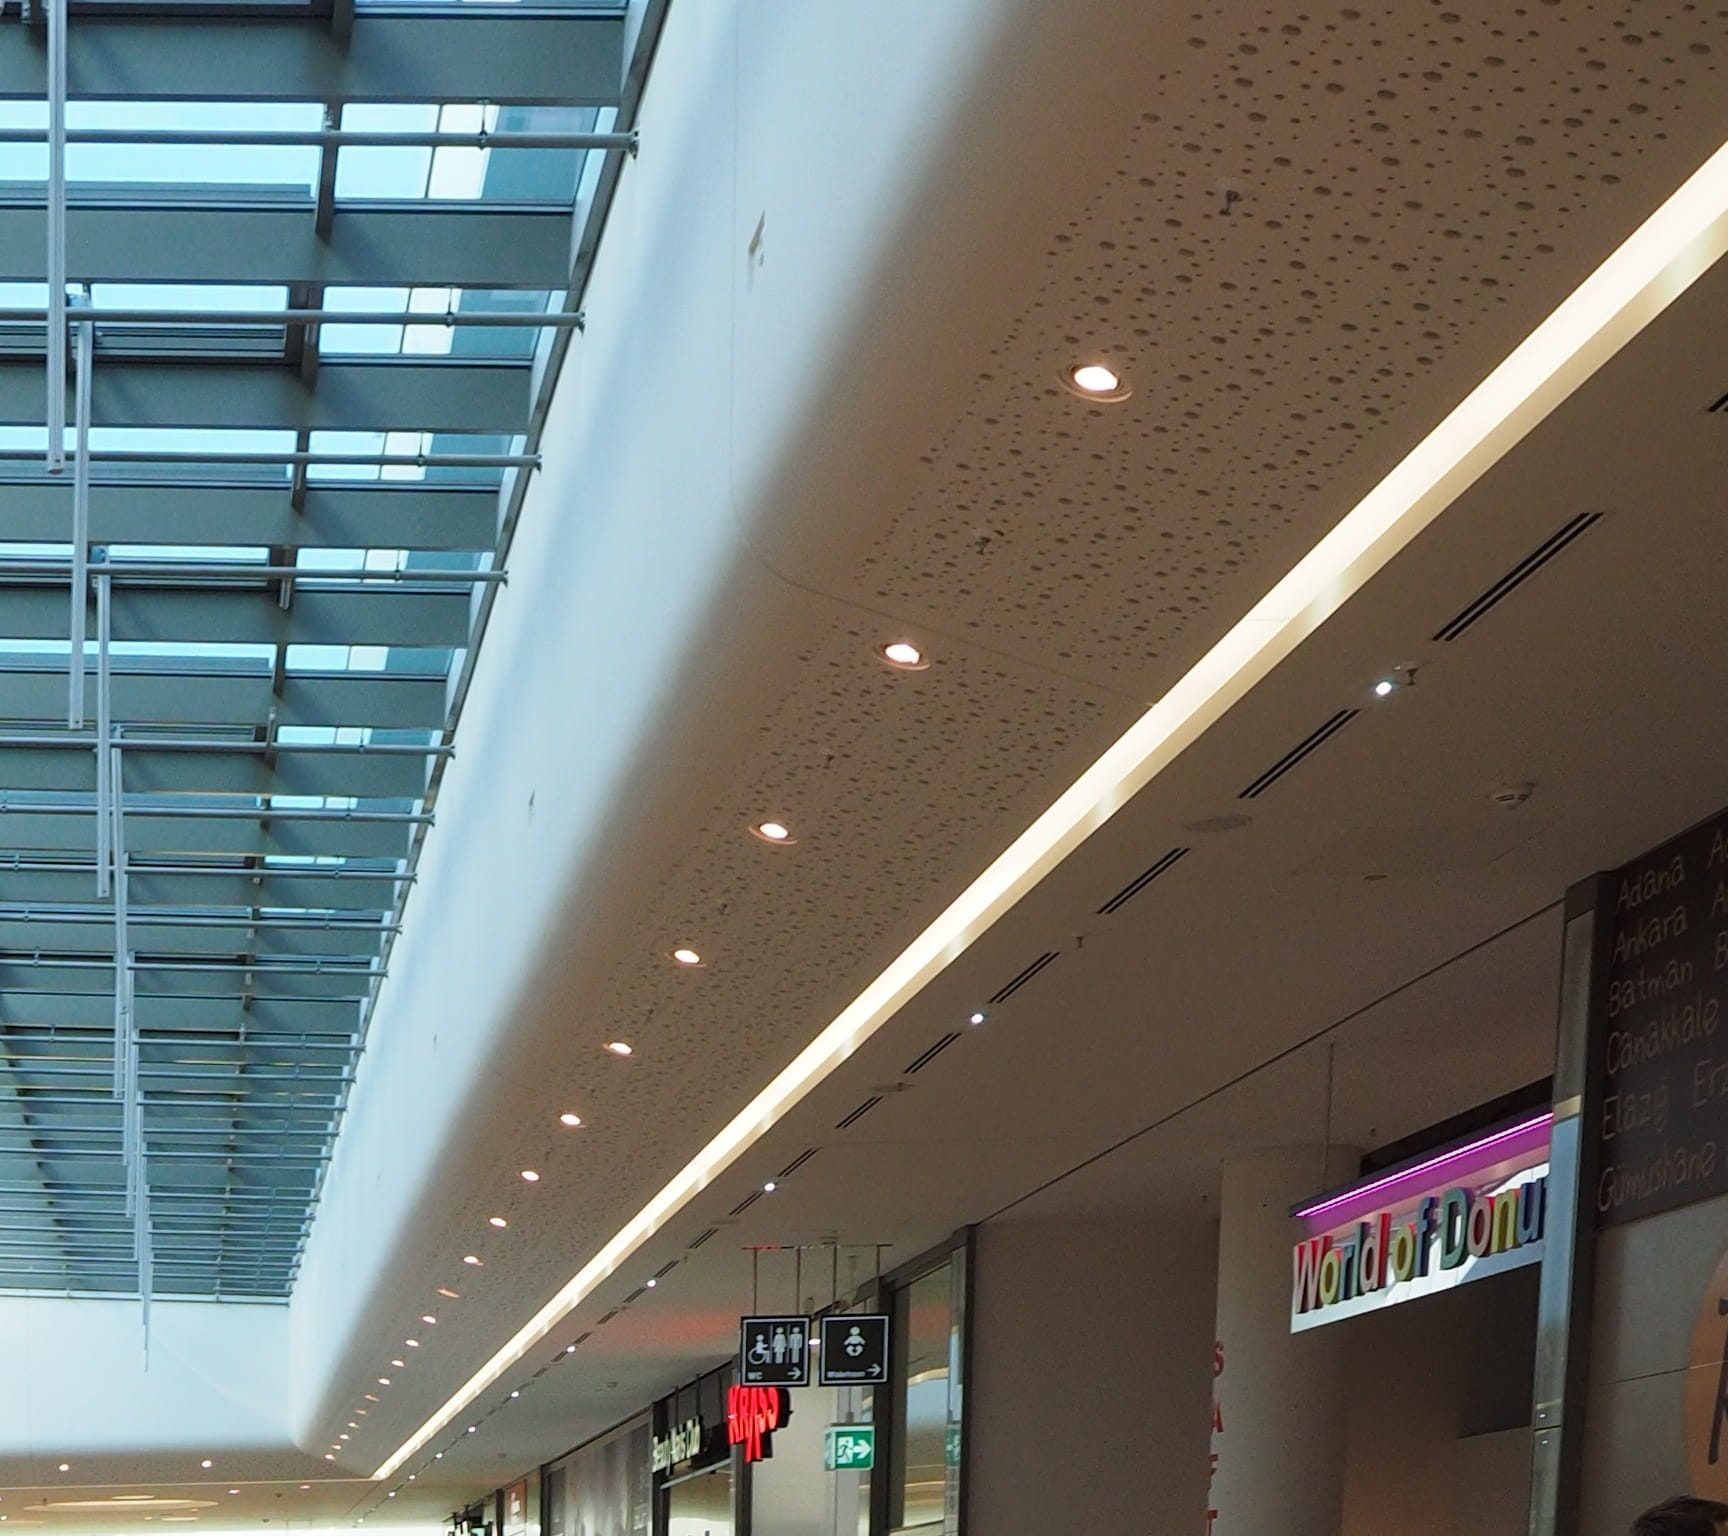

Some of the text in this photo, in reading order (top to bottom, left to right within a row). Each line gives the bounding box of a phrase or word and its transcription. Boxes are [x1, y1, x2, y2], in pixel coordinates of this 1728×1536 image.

[1616, 855, 1686, 912] Adana
[1610, 904, 1688, 966] Ankara
[1608, 958, 1693, 1018] Batman
[1293, 1213, 1391, 1314] World
[1392, 1196, 1436, 1282] of
[727, 1385, 780, 1464] KRASS
